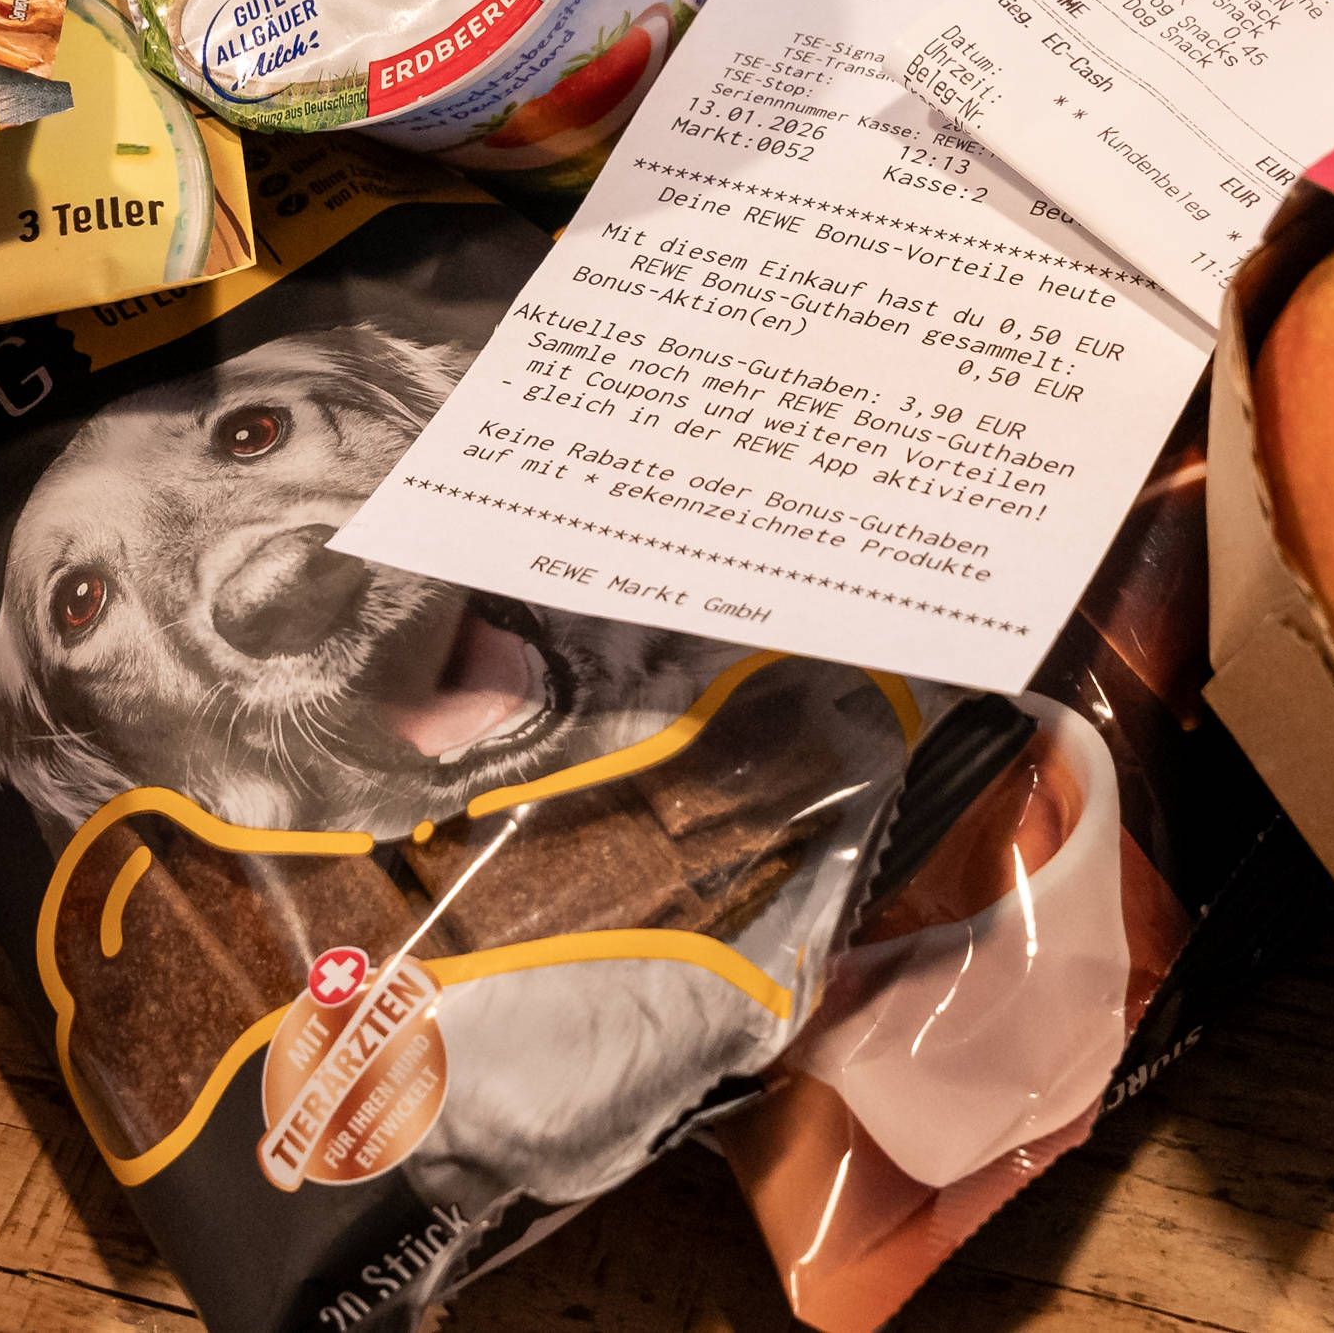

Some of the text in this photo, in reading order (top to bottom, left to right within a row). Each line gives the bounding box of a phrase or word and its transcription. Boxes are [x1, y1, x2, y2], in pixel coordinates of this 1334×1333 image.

[941, 24, 1002, 76] Datum:
[1159, 26, 1213, 69] Snack
[1177, 15, 1237, 66] Snacks
[303, 86, 367, 116] Deutschland
[689, 97, 970, 175] 13.01.2026 12:13
[1041, 32, 1114, 93] EC-Cash
[1219, 177, 1261, 209] EUR
[670, 116, 988, 203] Markt:0052 Kasse:2
[1097, 126, 1211, 221] Kundenbeleg
[1255, 155, 1296, 186] EUR
[18, 197, 165, 243] 3 Teller
[657, 186, 1116, 308] Deine REWE Bonus-Vorteile heute
[572, 266, 1084, 403] Bonus-Aktion(en) 0,50 EUR
[601, 222, 1125, 361] Mit diesem Einkauf hast du 0,50 EUR
[629, 254, 1075, 376] REWE Bonus-Guthaben gesammelt:
[513, 302, 1027, 440] Aktuelles Bonus-Guthaben: 3,90 EUR
[527, 331, 1075, 478] Sammle noch mehr REWE Bonus-Guthaben
[523, 384, 1048, 522] gleich in der REWE App aktivieren!
[525, 360, 1046, 496] mit Coupons und weiteren Vorteilen
[463, 444, 991, 582] auf mit gekennzeichnete Produkte
[478, 420, 989, 558] Keine Rabatte oder Bonus-Guthaben
[529, 555, 772, 623] REWE Markt GmbH
[270, 970, 427, 1171] TIERÄRZTEN
[287, 1013, 330, 1070] MIT
[323, 1077, 396, 1170] FÜR IHREN
[354, 1066, 440, 1170] ENTWICKELT
[362, 1202, 471, 1296] Stück
